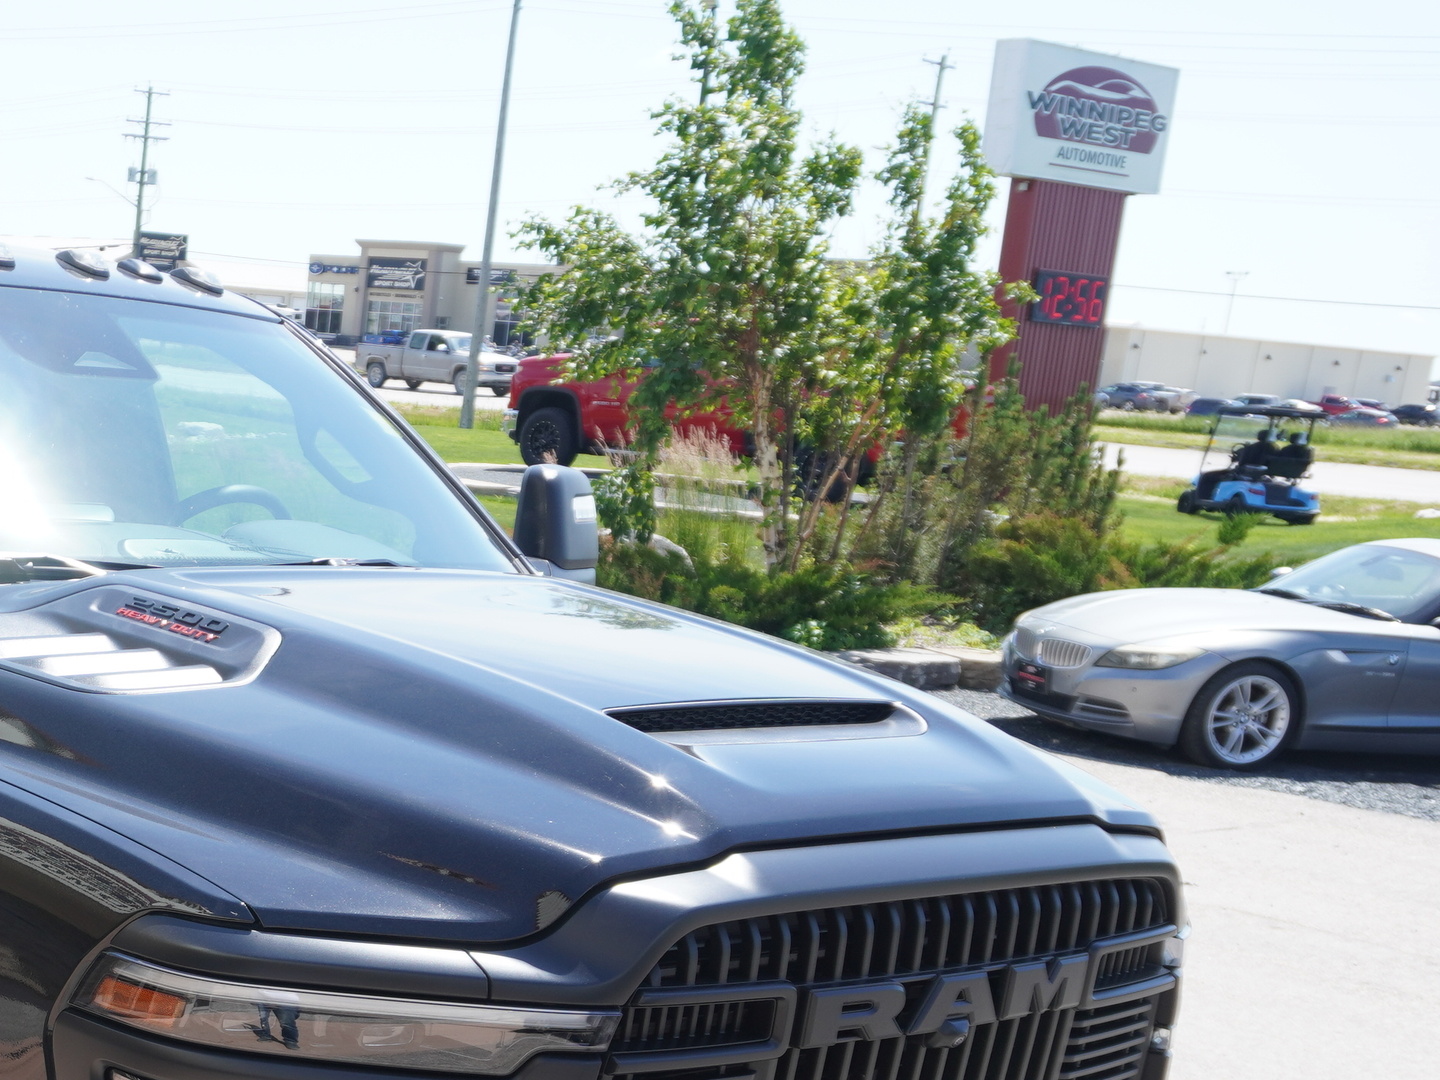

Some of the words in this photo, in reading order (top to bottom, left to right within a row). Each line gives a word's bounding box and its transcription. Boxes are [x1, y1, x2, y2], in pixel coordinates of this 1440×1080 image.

[1027, 90, 1168, 133] WINNIPEG
[1059, 116, 1138, 148] WEST
[1056, 146, 1128, 169] AUTOMOTIVE
[394, 280, 411, 288] SHOP
[1042, 276, 1105, 323] 12:56
[116, 607, 174, 628] HEAVY
[168, 622, 221, 643] DUTY
[125, 596, 230, 634] 2500
[799, 952, 1090, 1050] RAM
